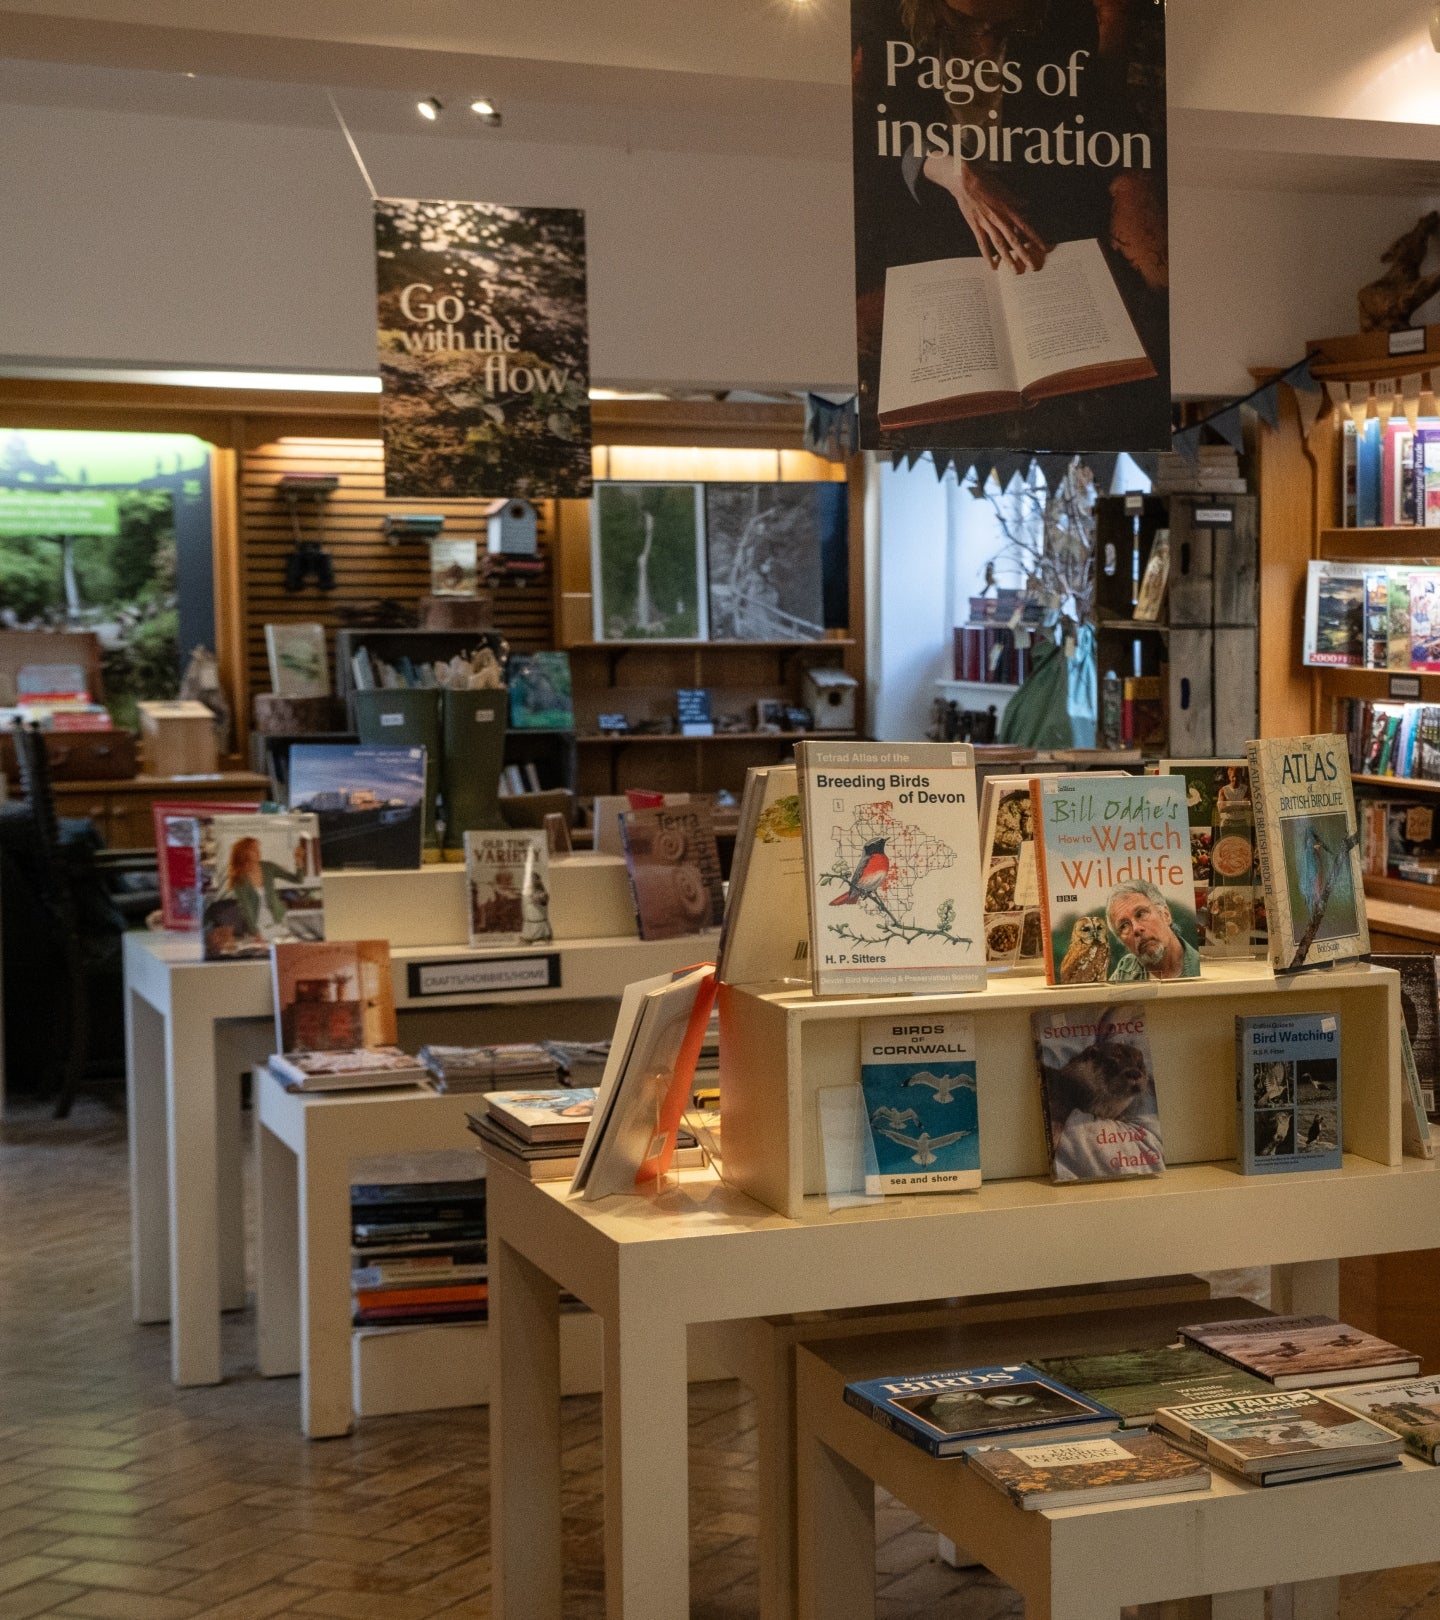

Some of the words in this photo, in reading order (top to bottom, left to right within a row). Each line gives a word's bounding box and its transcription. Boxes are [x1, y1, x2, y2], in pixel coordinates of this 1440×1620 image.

[886, 40, 1023, 105] Pages
[1036, 50, 1090, 97] of
[877, 103, 1151, 177] inspiration
[400, 282, 465, 323] Go
[401, 323, 465, 351] with
[473, 325, 520, 353] the
[485, 355, 569, 394] flow
[1310, 654, 1337, 663] 2000
[816, 753, 849, 763] Tetrad
[851, 752, 878, 763] Atlas
[881, 753, 891, 763] of
[893, 753, 910, 763] the
[1249, 747, 1258, 765] THE
[1282, 751, 1337, 784] ATLAS
[817, 775, 885, 790] Breeding
[890, 775, 930, 787] Birds
[1251, 769, 1262, 799] ATLAS
[899, 791, 913, 804] of
[918, 791, 965, 804] Devon
[1280, 795, 1310, 811] BRITISH
[1311, 793, 1343, 808] BIRDLIFE
[1050, 795, 1094, 824] Bill
[1103, 796, 1179, 824] Oddie's
[1255, 802, 1264, 815] OF
[655, 812, 698, 832] Terra
[1058, 834, 1081, 844] How
[1082, 835, 1092, 844] to
[1091, 821, 1181, 853] Watch
[1256, 817, 1268, 857] BRITISH
[1060, 855, 1184, 889] Wildlife
[1260, 858, 1273, 896] BIRDLIFE
[826, 955, 837, 964] H.
[840, 955, 849, 964] P.
[852, 954, 886, 964] Sitters
[425, 970, 545, 987] CRAFTS/HOBBIES/HOME
[821, 977, 844, 985] Devon
[862, 975, 897, 985] Watching
[904, 974, 950, 983] Preservation
[952, 973, 979, 982] Society
[892, 1025, 945, 1036] BIRDS
[1044, 1020, 1145, 1040] stormorce
[1253, 1032, 1277, 1044] Bird
[1279, 1030, 1334, 1043] Watching
[872, 1044, 966, 1056] CORNWALL
[1096, 1126, 1146, 1145] david
[1110, 1151, 1161, 1169] chaffe
[910, 1175, 928, 1184] and
[931, 1174, 958, 1183] shore
[880, 1372, 1015, 1394] BIRDS
[1175, 1384, 1223, 1394] Wildlife
[1171, 1402, 1233, 1417] HUGH
[1181, 1408, 1241, 1422] Nature
[1241, 1399, 1320, 1415] Detective
